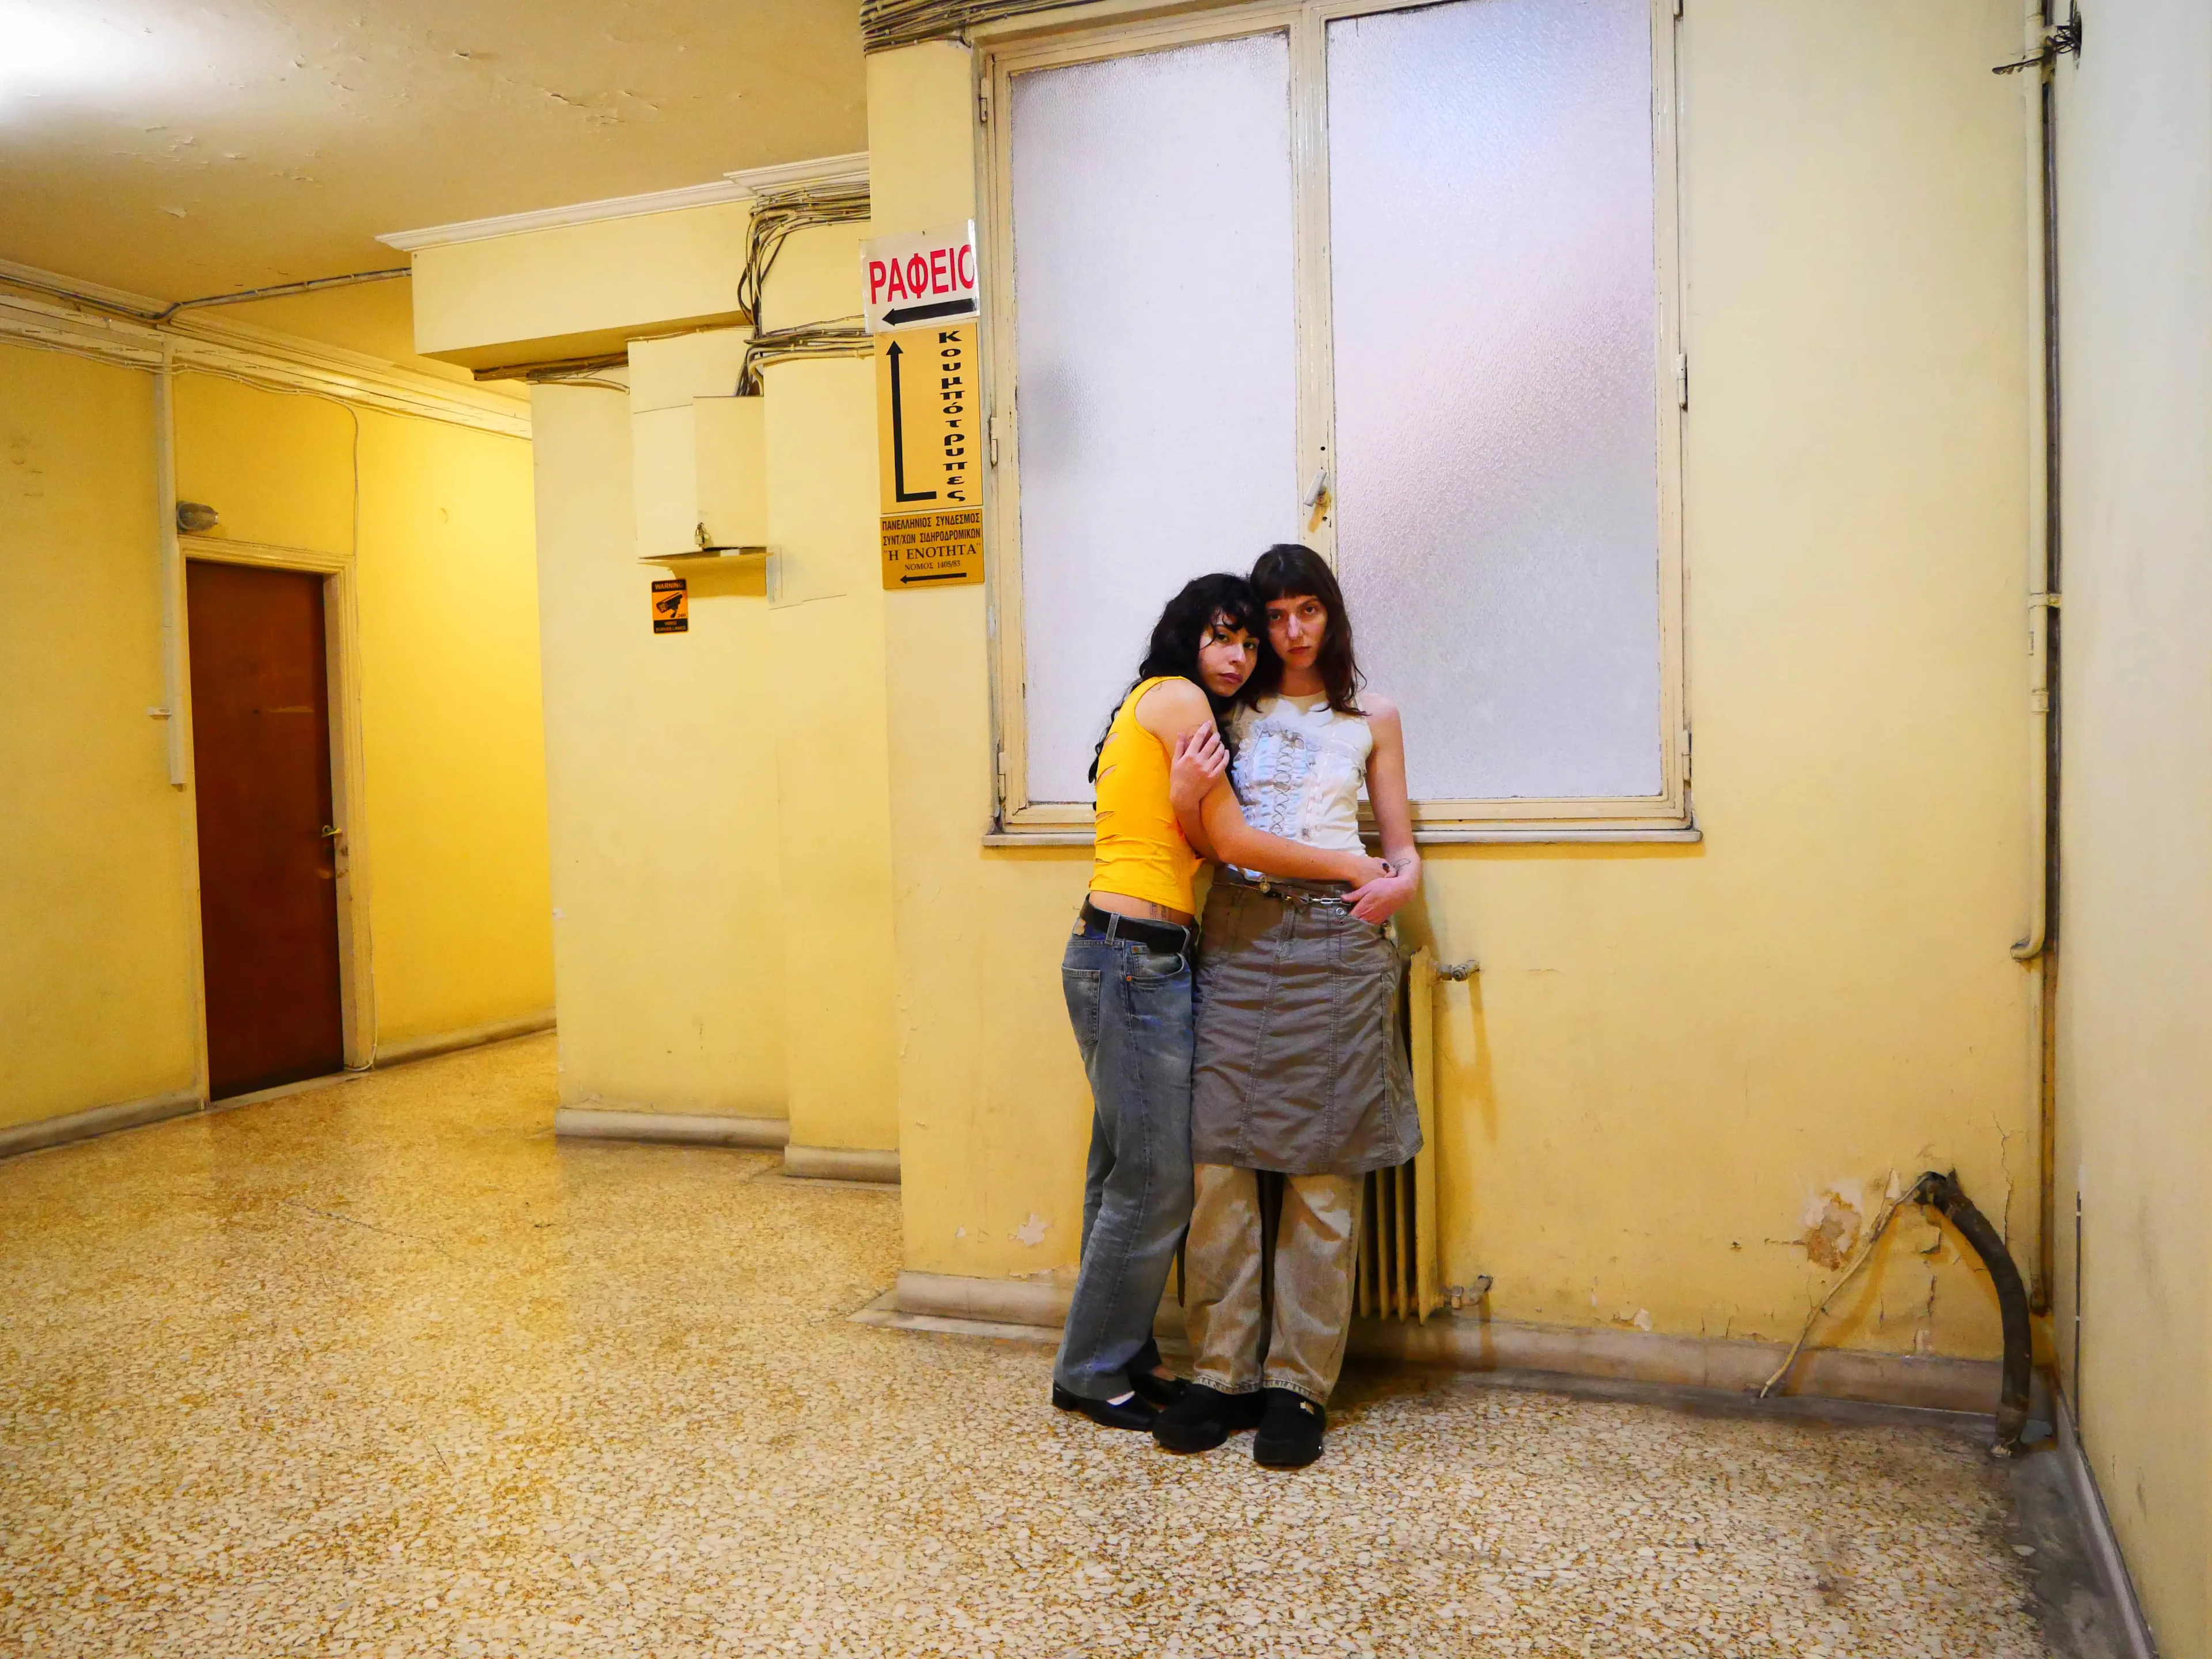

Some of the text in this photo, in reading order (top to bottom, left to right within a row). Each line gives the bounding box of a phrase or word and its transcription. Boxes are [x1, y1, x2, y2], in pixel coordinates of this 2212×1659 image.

[938, 330, 968, 502] Κουμπότρυπες
[882, 513, 980, 531] ΠΑΝΕΛΛΗΝΙΟΣ ΣΥΝΔΕΣΜΟΣ
[883, 528, 980, 546] ΣΥΝΤ/ΧΩΝ ΣΙΔΗΡΟΔΡΟΜΙΚΩΝ
[905, 560, 960, 571] ΝΟΜΟΣ 1405/83
